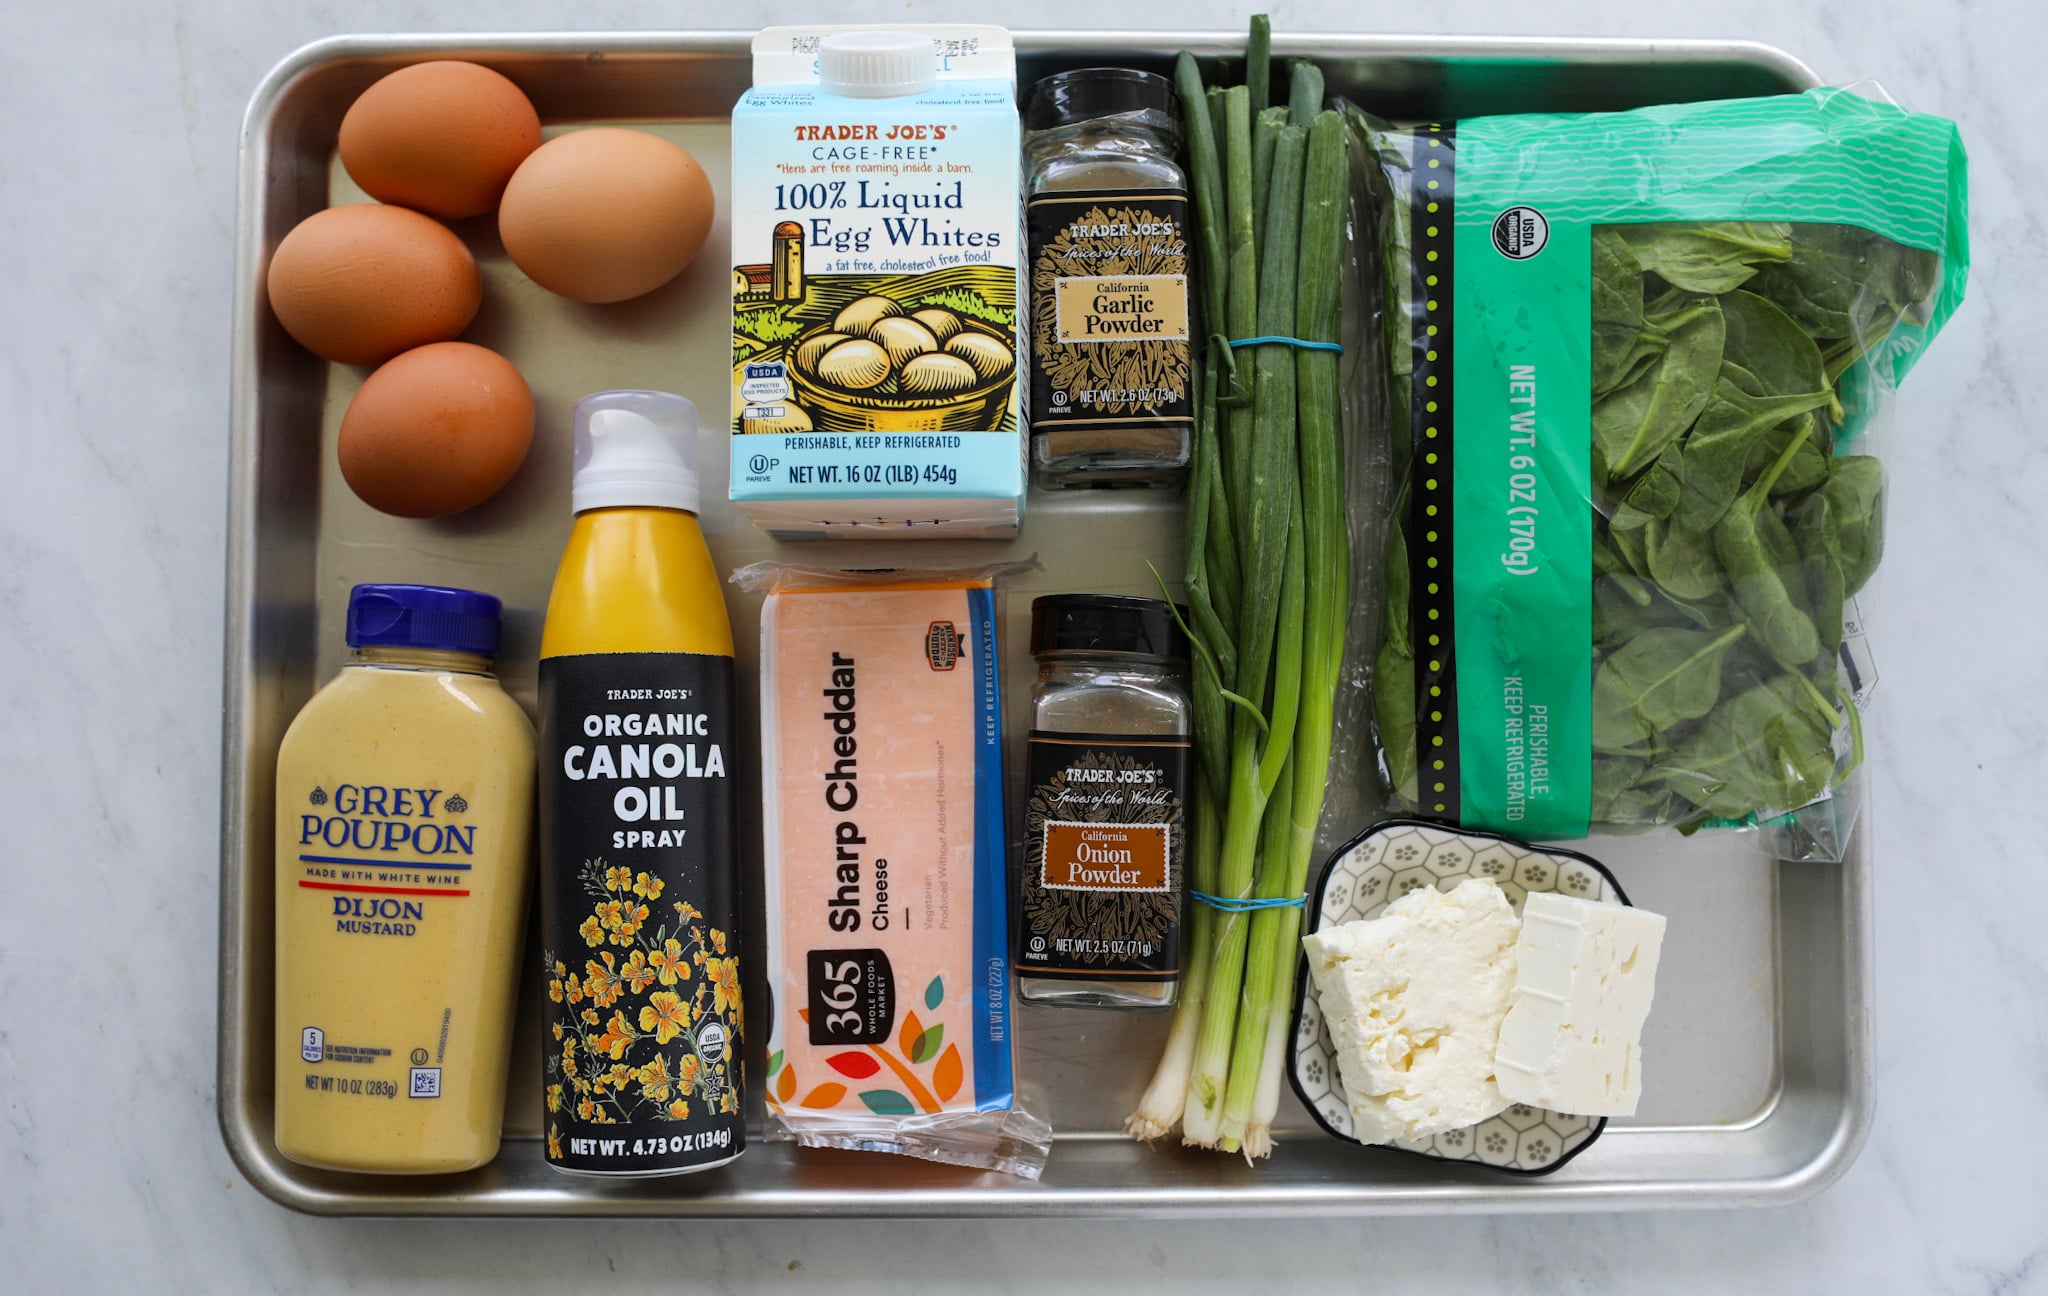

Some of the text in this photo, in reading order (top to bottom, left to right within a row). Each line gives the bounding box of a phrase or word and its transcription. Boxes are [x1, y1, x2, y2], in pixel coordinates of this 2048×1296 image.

[794, 125, 878, 141] TRADER
[810, 165, 826, 174] are
[831, 163, 851, 173] free
[855, 163, 899, 176] roaming
[902, 162, 932, 173] inside
[937, 165, 943, 173] a
[947, 162, 974, 174] barn.
[774, 180, 963, 215] 100% Liquid
[810, 217, 1001, 252] Egg Whites
[1070, 223, 1129, 238] TRADER
[1508, 215, 1518, 251] ORGANIC
[1523, 219, 1534, 247] USDA
[826, 250, 991, 272] a fat free, cholesterol free food!
[1057, 243, 1105, 266] Spices
[1118, 244, 1141, 257] the
[1149, 242, 1187, 257] World
[1097, 283, 1149, 293] California
[1093, 295, 1154, 314] Garlic
[1085, 314, 1164, 334] Powder
[752, 369, 778, 377] USDA
[1080, 388, 1177, 403] NET WT. 2.6 OZ (73g)
[1049, 406, 1072, 414] PAREVE
[785, 436, 961, 451] PERISHABLE, KEEP REFRIGERATED
[789, 465, 957, 485] NET WT. 16 OZ (1LB) 454g
[1501, 365, 1538, 575] NET WT. 6 OZ (170g)
[932, 626, 941, 667] PROUDLY
[984, 621, 995, 744] KEEP REFRIGERATED
[607, 690, 653, 700] TRADER
[584, 713, 708, 737] ORGANIC
[1504, 677, 1525, 821] KEEP REFRIGERATED
[1528, 705, 1548, 799] PERISHABLE,
[564, 743, 726, 780] CANOLA
[1066, 768, 1114, 783] TRADER
[335, 784, 443, 818] GREY
[823, 652, 867, 932] Sharp Cheddar
[1049, 788, 1092, 809] Spices
[1103, 791, 1124, 805] the
[1129, 789, 1172, 805] World
[614, 786, 684, 822] OIL
[937, 800, 946, 833] Added
[299, 814, 477, 855] POUPON
[612, 829, 686, 849] SPRAY
[1081, 830, 1128, 842] California
[938, 837, 947, 878] Without
[1076, 842, 1132, 864] Onion
[307, 867, 461, 885] MADE WITH WHITE WINE
[1068, 862, 1141, 885] Powder
[872, 858, 889, 931] Cheese
[924, 875, 934, 930] Vegetarian
[940, 881, 949, 929] Produced
[333, 896, 423, 921] DIJON
[336, 920, 416, 937] MUSTARD
[1026, 952, 1048, 961] PAREVE
[1056, 938, 1151, 957] NET WT. 2.5 OZ (71g)
[988, 957, 1004, 987] (227g)
[821, 960, 863, 1035] 365
[878, 976, 886, 1017] MARKET
[989, 989, 1002, 1000] OZ
[990, 1010, 1003, 1023] WT
[310, 1032, 316, 1045] 5
[705, 1033, 720, 1042] USDA
[990, 1025, 1004, 1042] NET
[305, 1074, 398, 1099] NET WT 10 OZ (283g)
[571, 1127, 732, 1156] NET WT. 4.73 OZ (134g)
